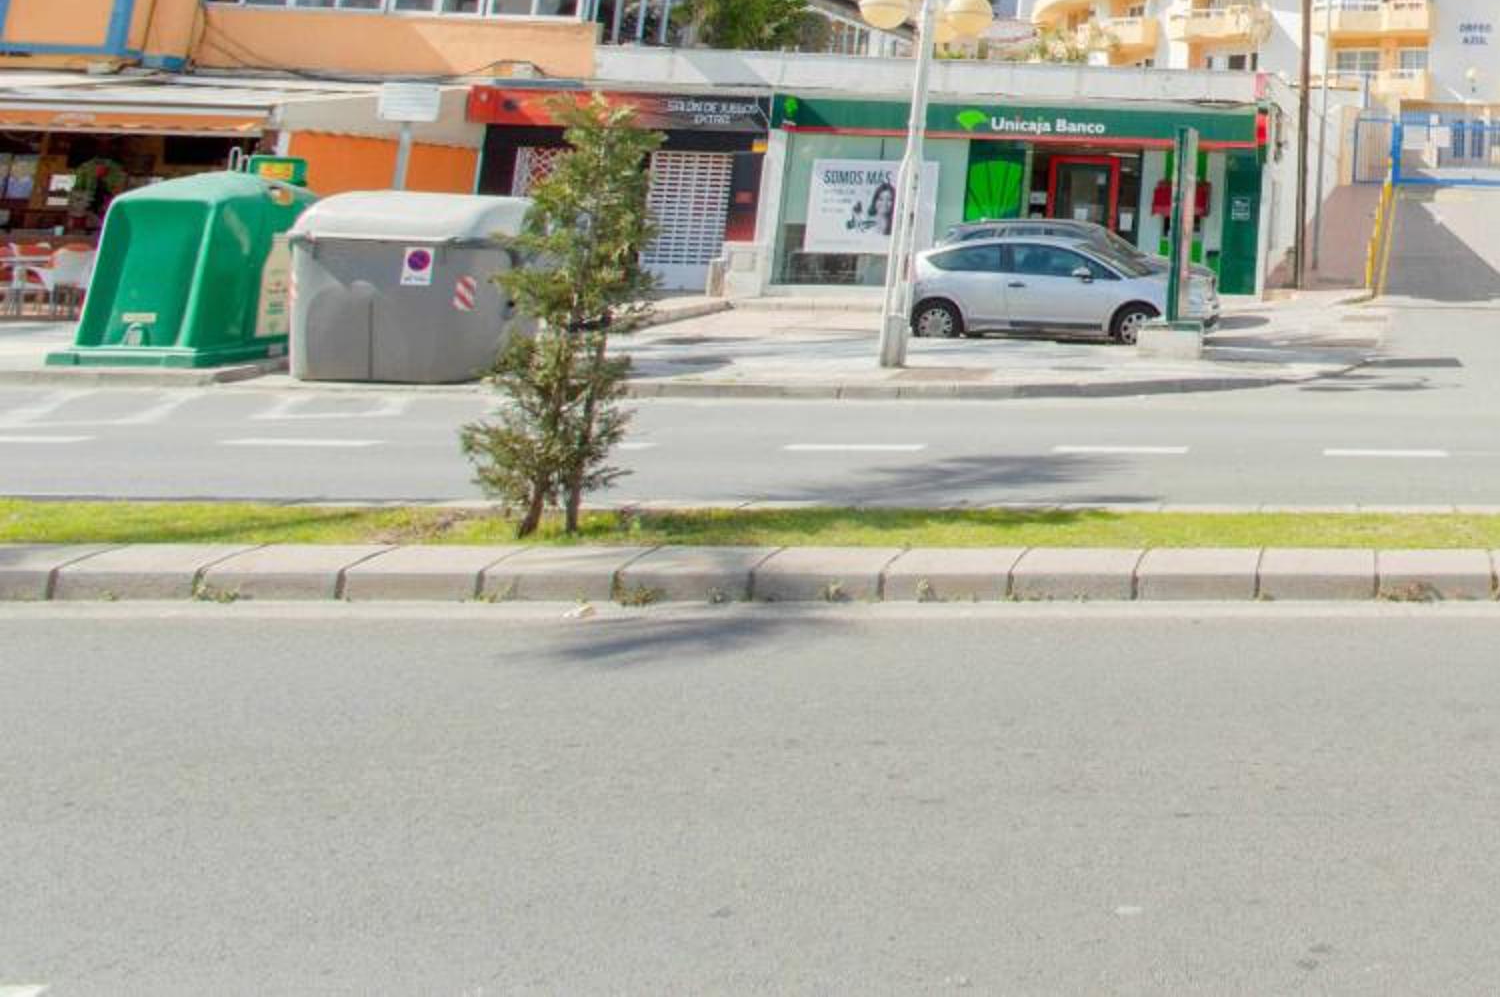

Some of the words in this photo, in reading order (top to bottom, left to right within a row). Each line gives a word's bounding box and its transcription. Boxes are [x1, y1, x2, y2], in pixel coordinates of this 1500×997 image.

[991, 116, 1052, 135] Unicaja
[1055, 118, 1105, 134] Banco
[823, 169, 864, 185] SOMOS
